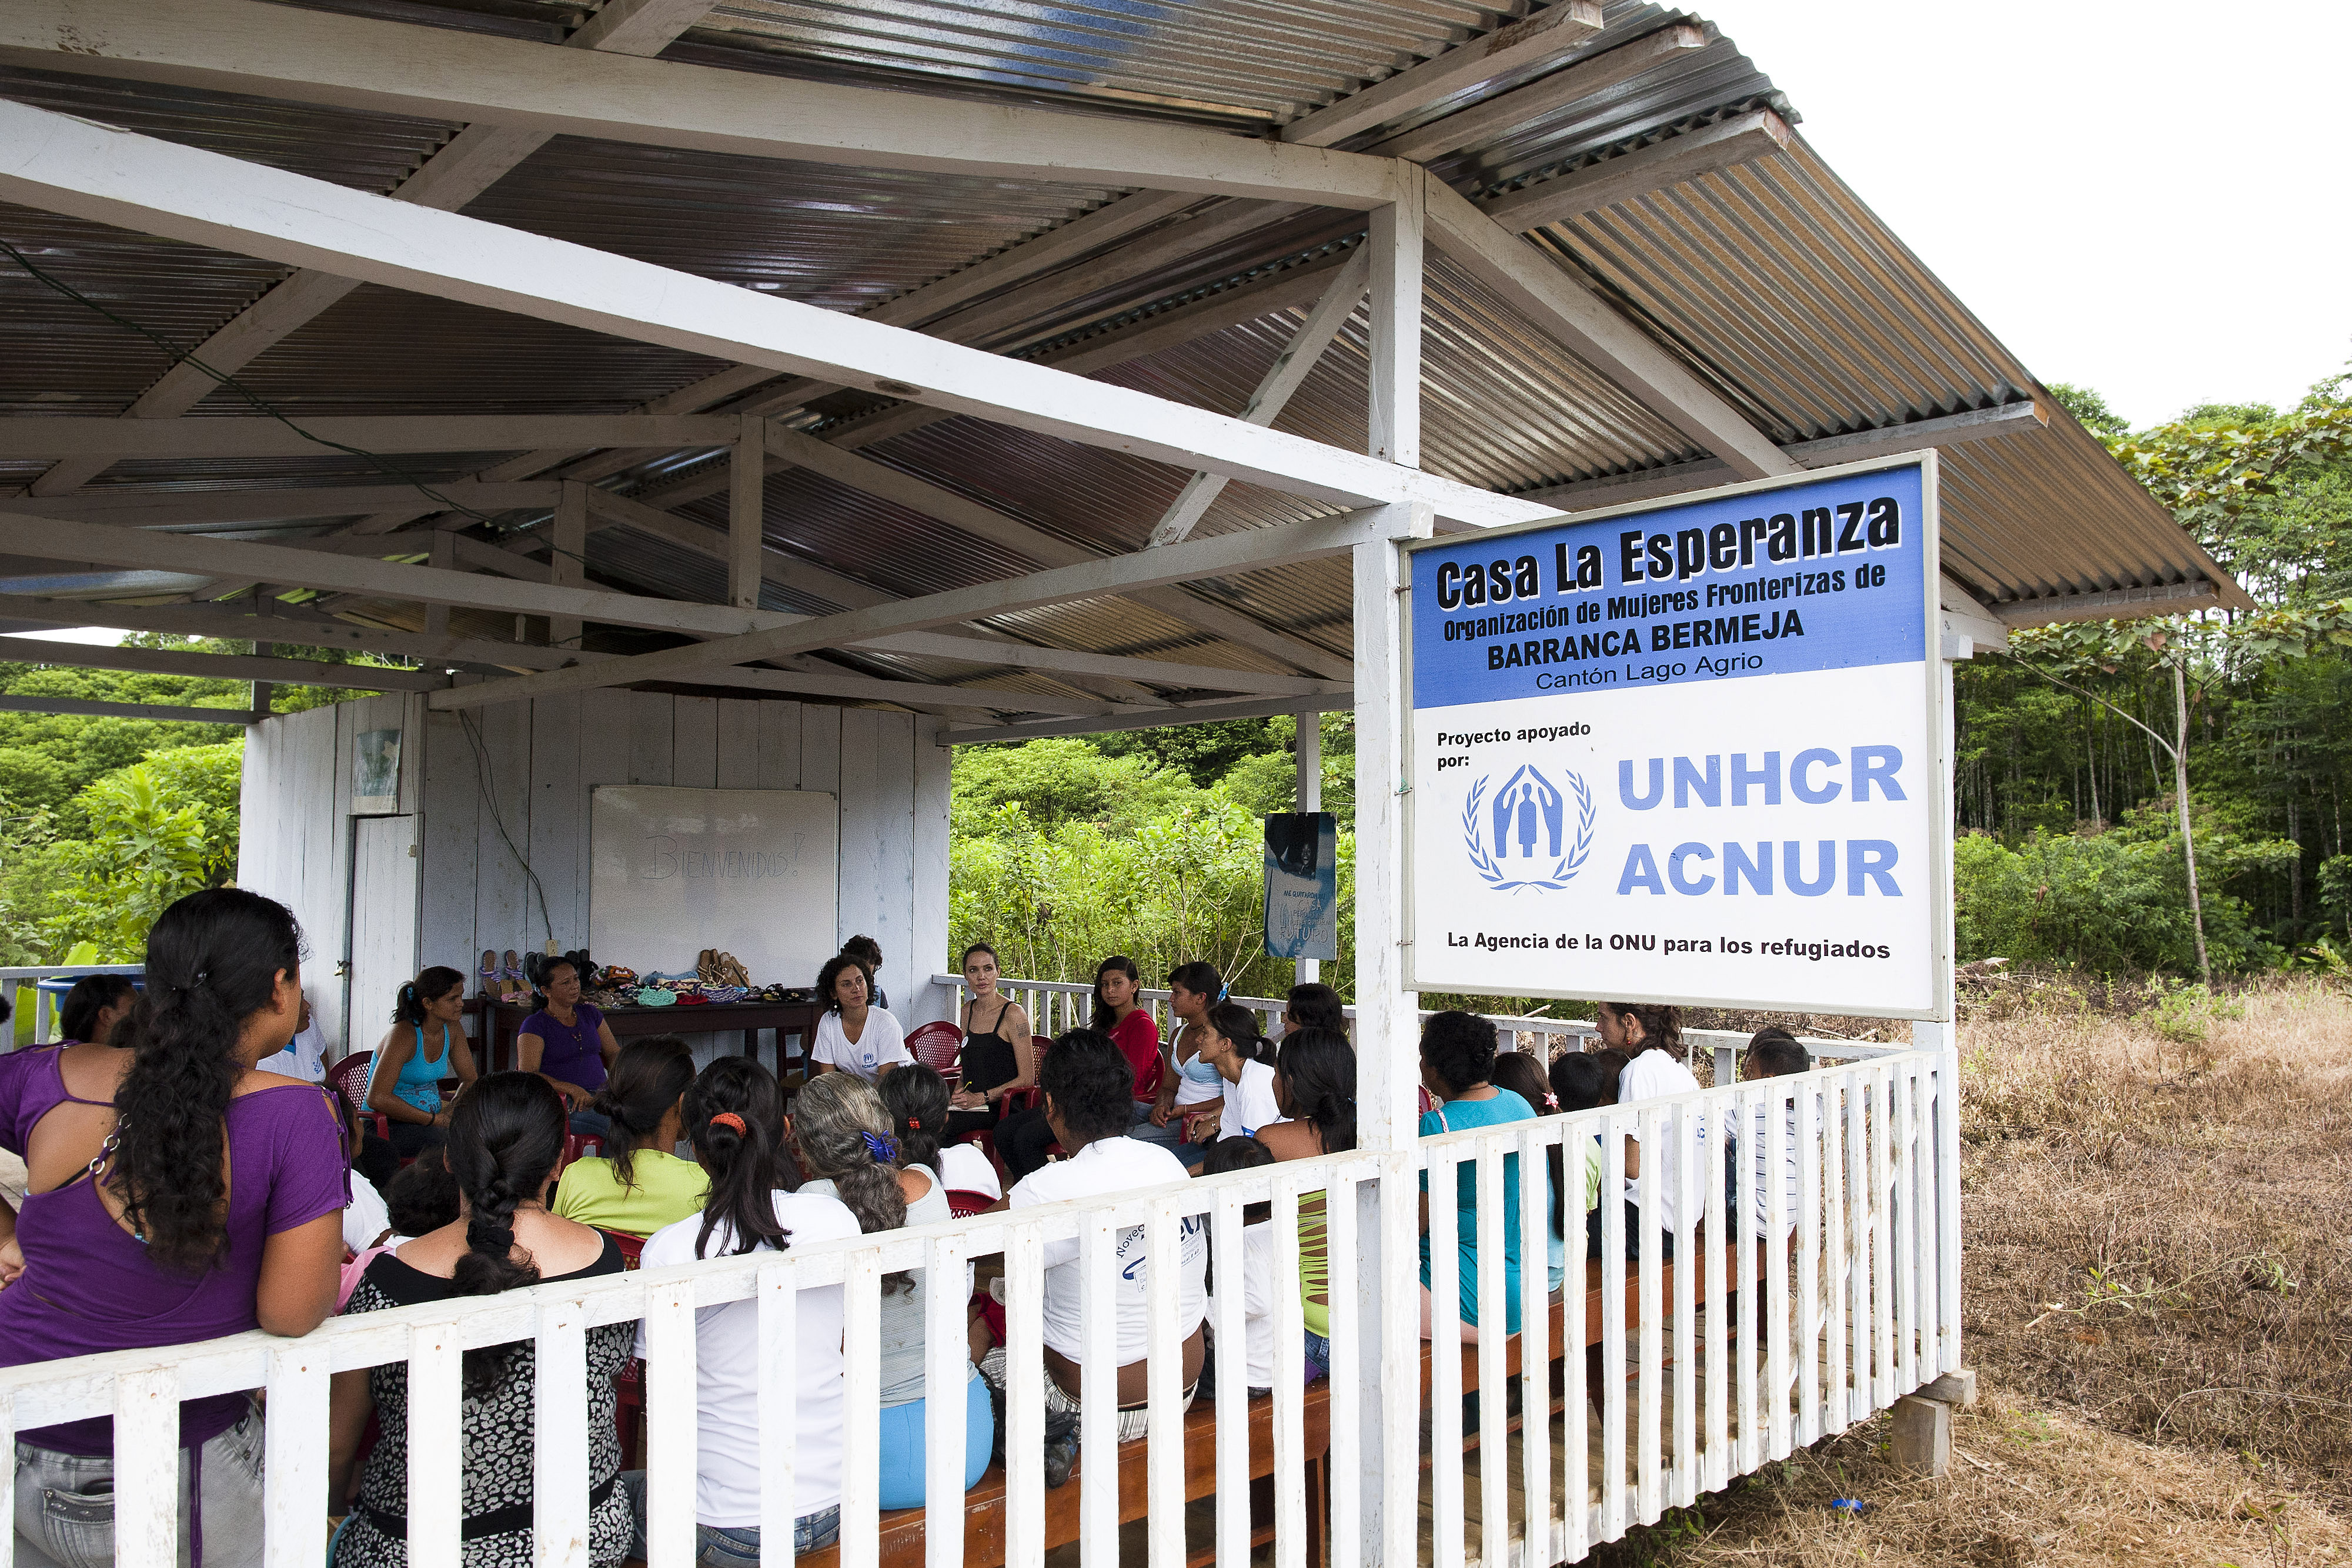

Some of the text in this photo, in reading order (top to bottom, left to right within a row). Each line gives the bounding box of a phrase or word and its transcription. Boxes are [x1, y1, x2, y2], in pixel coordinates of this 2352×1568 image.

[1437, 497, 1901, 611] Casa La Esperanza
[1444, 563, 1885, 641] Organización de Mujeres Fronterizas de
[1488, 609, 1805, 671] BARRANCA BERMEJA
[1536, 653, 1763, 690] Cantón Lago Agrio
[1438, 721, 1591, 748] Proyecto apoyado
[1438, 756, 1469, 771] por:
[1619, 745, 1907, 811] UNHCR
[1617, 840, 1903, 897] ACNUR
[1448, 932, 1890, 961] La Agencia de la ONU para los refugiados
